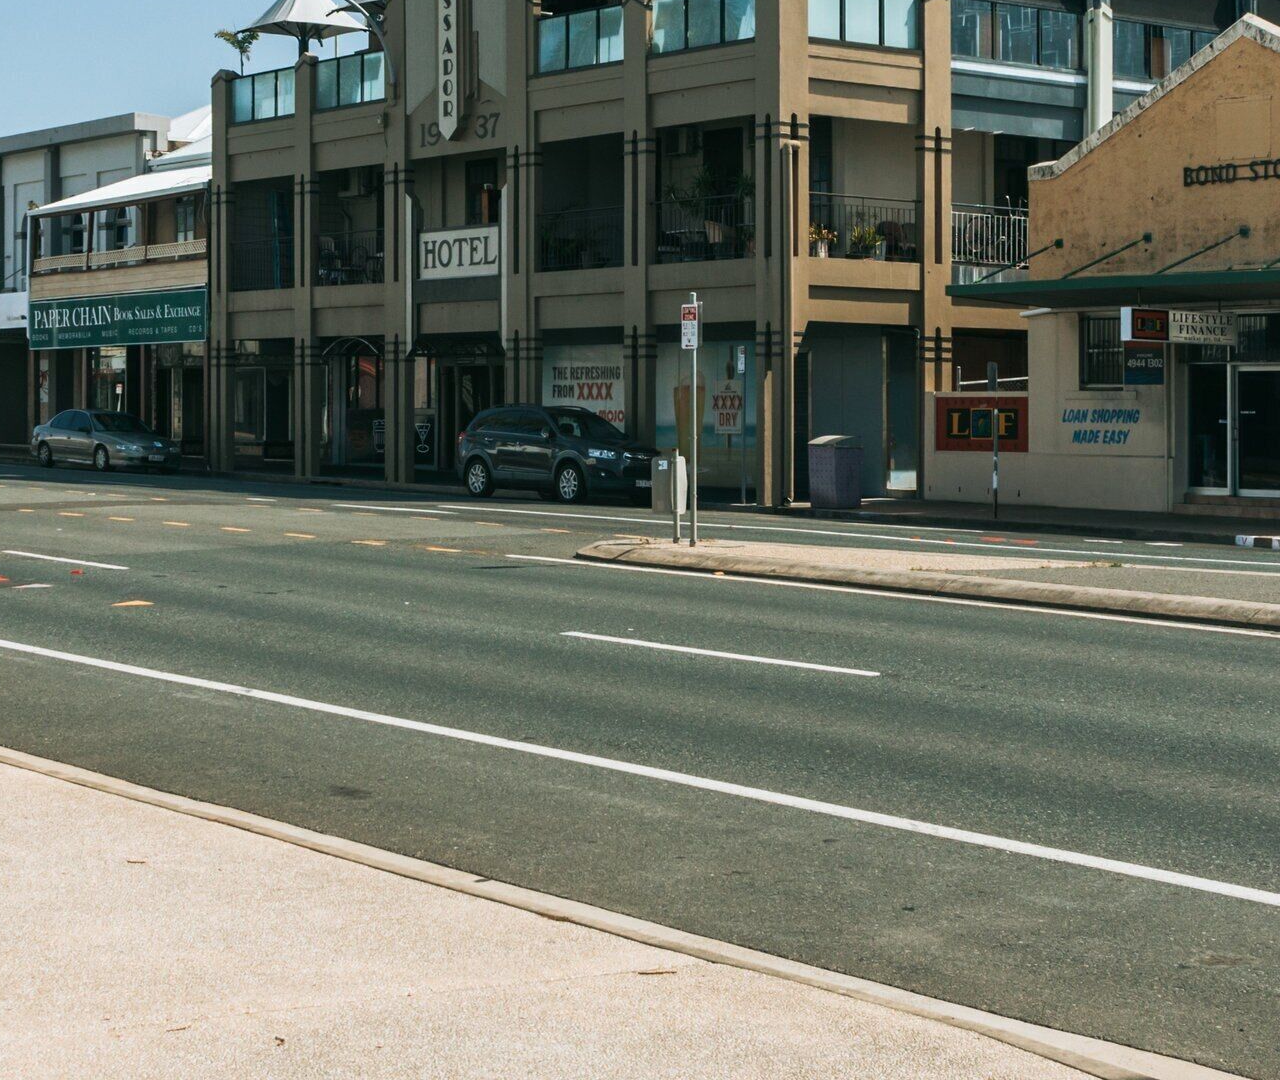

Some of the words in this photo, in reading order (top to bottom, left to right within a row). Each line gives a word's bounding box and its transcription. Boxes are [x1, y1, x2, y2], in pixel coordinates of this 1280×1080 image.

[419, 121, 441, 148] 19
[474, 112, 500, 140] 37
[1183, 163, 1237, 187] BOND
[423, 235, 497, 269] HOTEL
[34, 309, 70, 329] PAPER
[72, 305, 112, 327] CHAIN
[155, 305, 162, 320] &
[1173, 313, 1233, 326] LIFESTYLE
[32, 333, 49, 341] BOOKS
[58, 331, 91, 340] MEMORABILIA
[101, 329, 118, 337] MUSIC
[128, 327, 153, 335] RECORDS
[161, 326, 177, 334] TAPES
[1179, 325, 1228, 336] FINANCE
[1127, 359, 1146, 368] 4944
[1147, 359, 1164, 368] 1302
[552, 367, 568, 380] THE
[570, 366, 621, 380] REFRESHING
[552, 385, 575, 398] FROM
[577, 382, 613, 400] XXXX
[712, 395, 743, 409] XXXX
[719, 413, 738, 427] DRY
[1062, 409, 1089, 423] LOAN
[1090, 408, 1140, 424] SHOPPING
[1072, 430, 1100, 444] MADE
[1102, 429, 1130, 445] EASY
